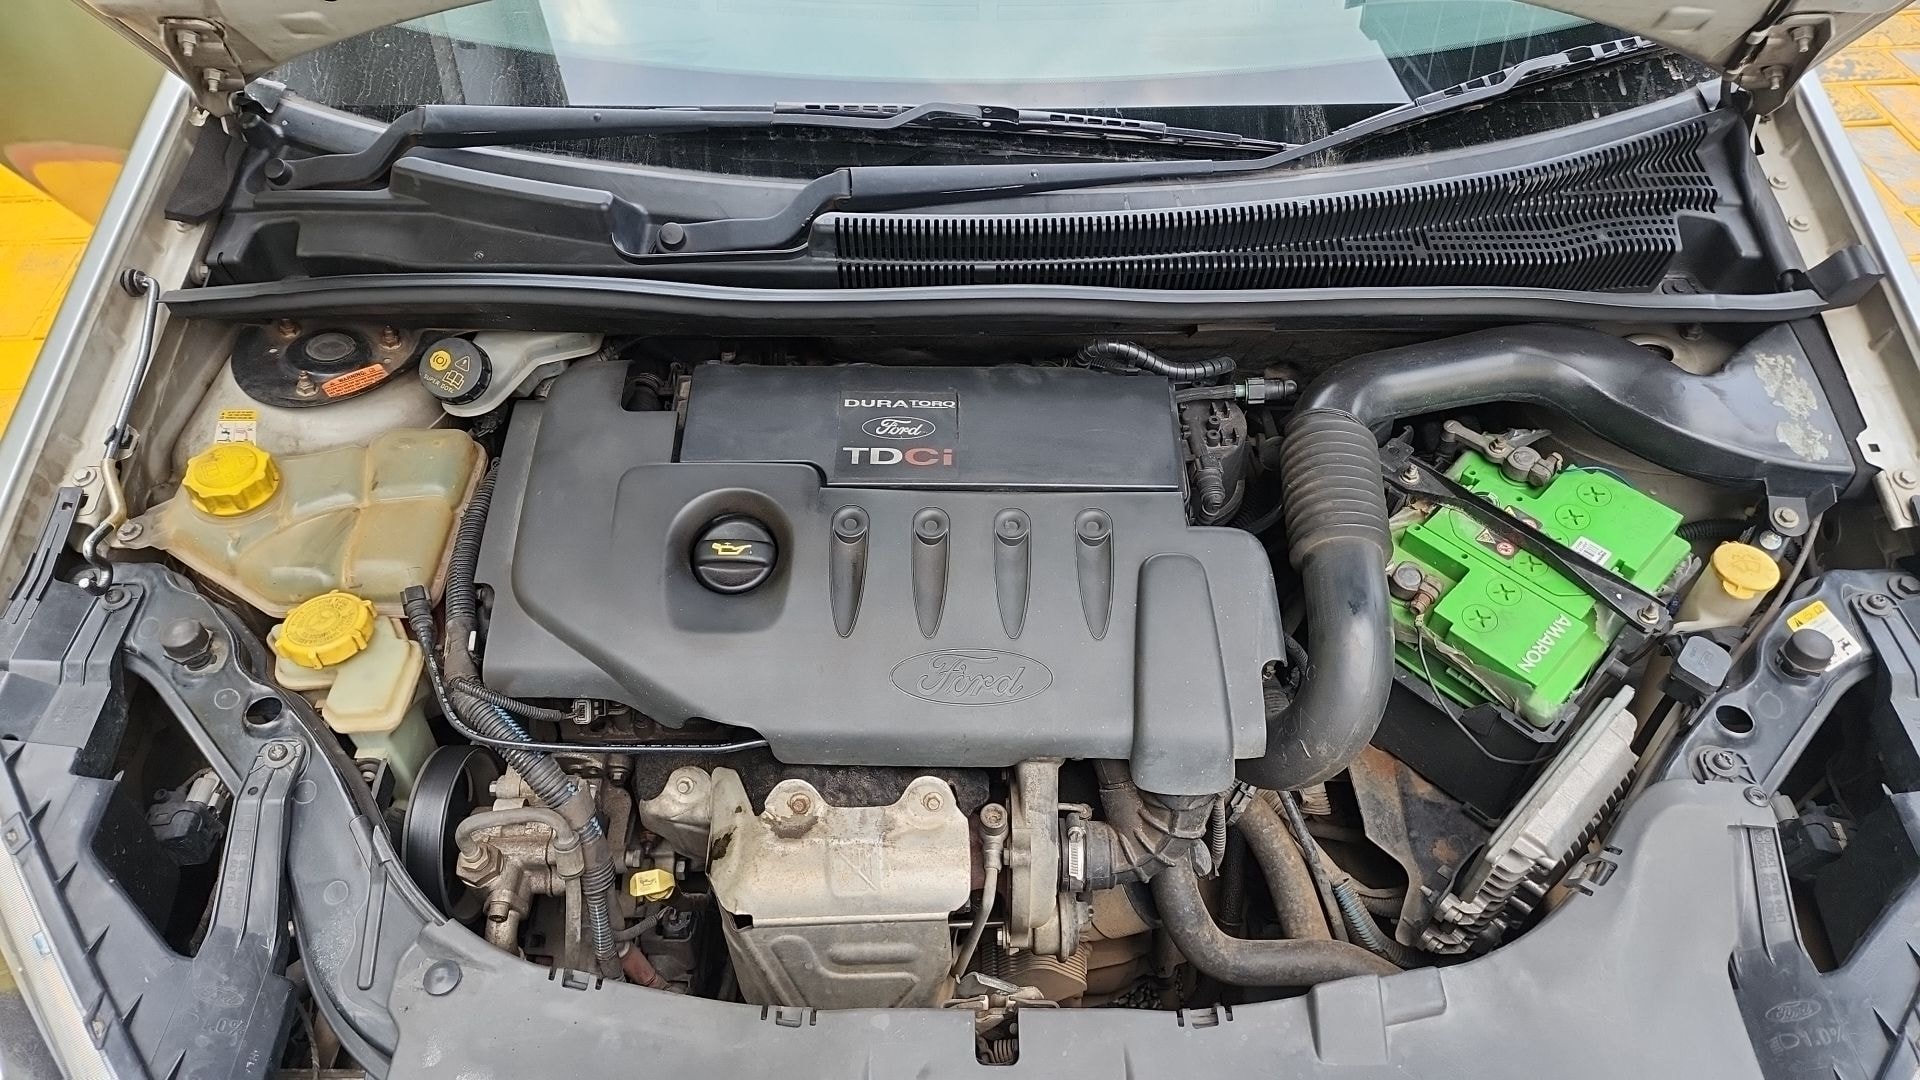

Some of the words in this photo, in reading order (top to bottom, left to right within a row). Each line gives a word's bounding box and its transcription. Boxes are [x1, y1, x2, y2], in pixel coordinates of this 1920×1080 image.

[875, 417, 924, 436] Ford
[842, 447, 953, 466] TDCi
[1516, 613, 1572, 674] AMARON
[916, 653, 1026, 697] Ford
